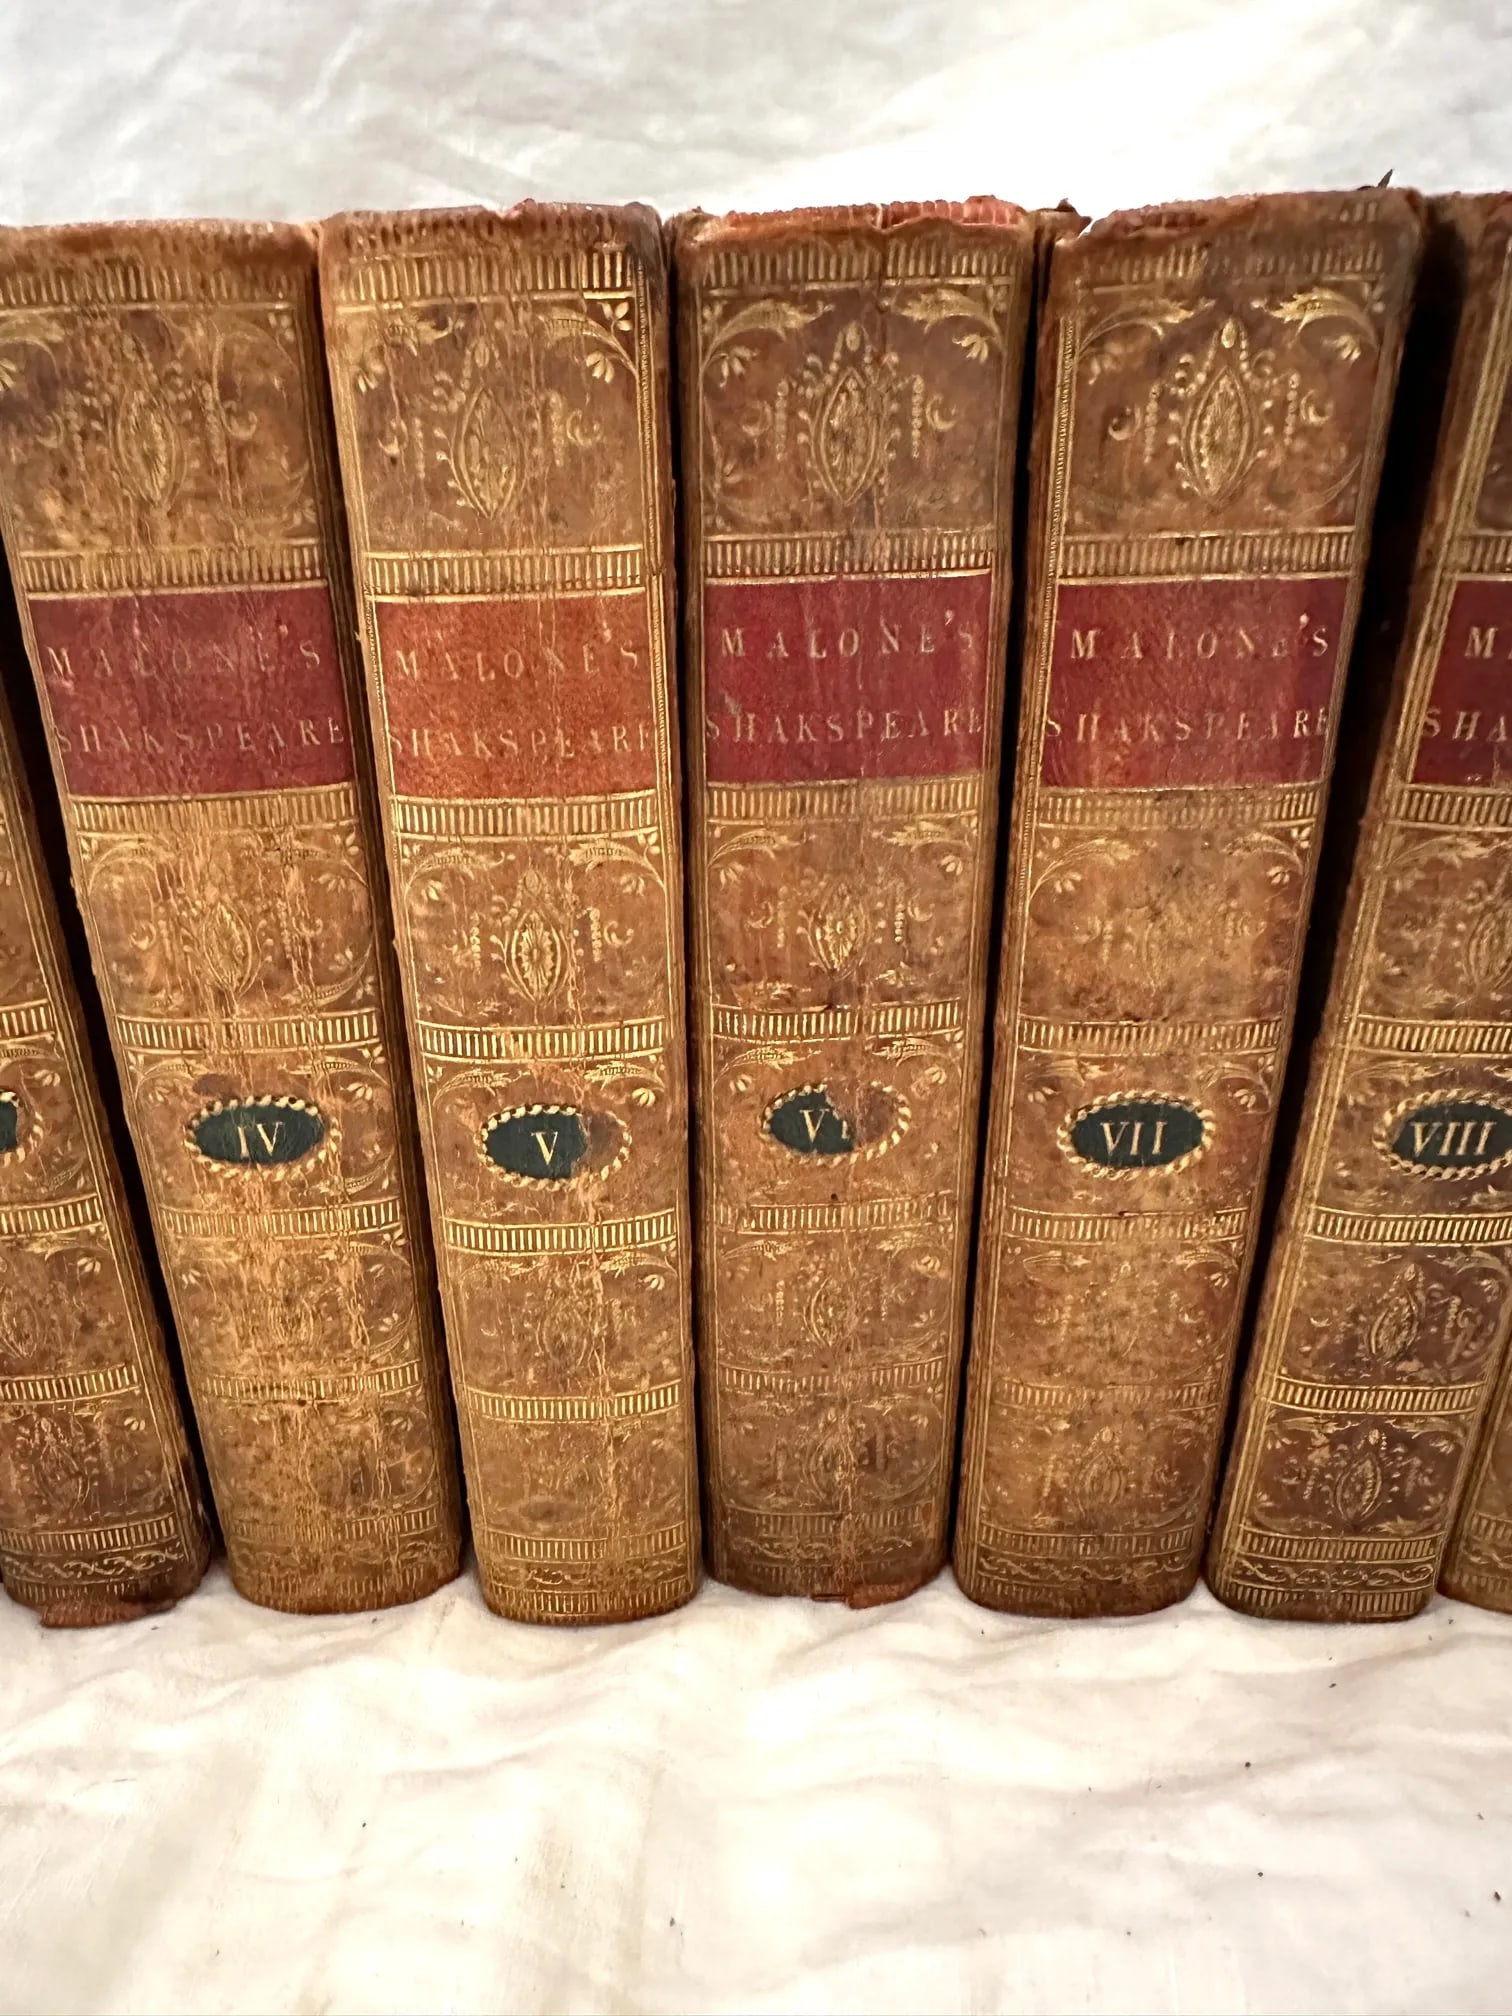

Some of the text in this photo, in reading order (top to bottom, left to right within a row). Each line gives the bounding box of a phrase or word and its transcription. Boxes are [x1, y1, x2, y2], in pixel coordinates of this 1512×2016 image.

[722, 609, 973, 659] MALONE'S
[1465, 626, 1512, 659] M
[236, 1121, 284, 1158] IV
[1100, 1121, 1167, 1155] VII
[1410, 1121, 1498, 1156] VIII
